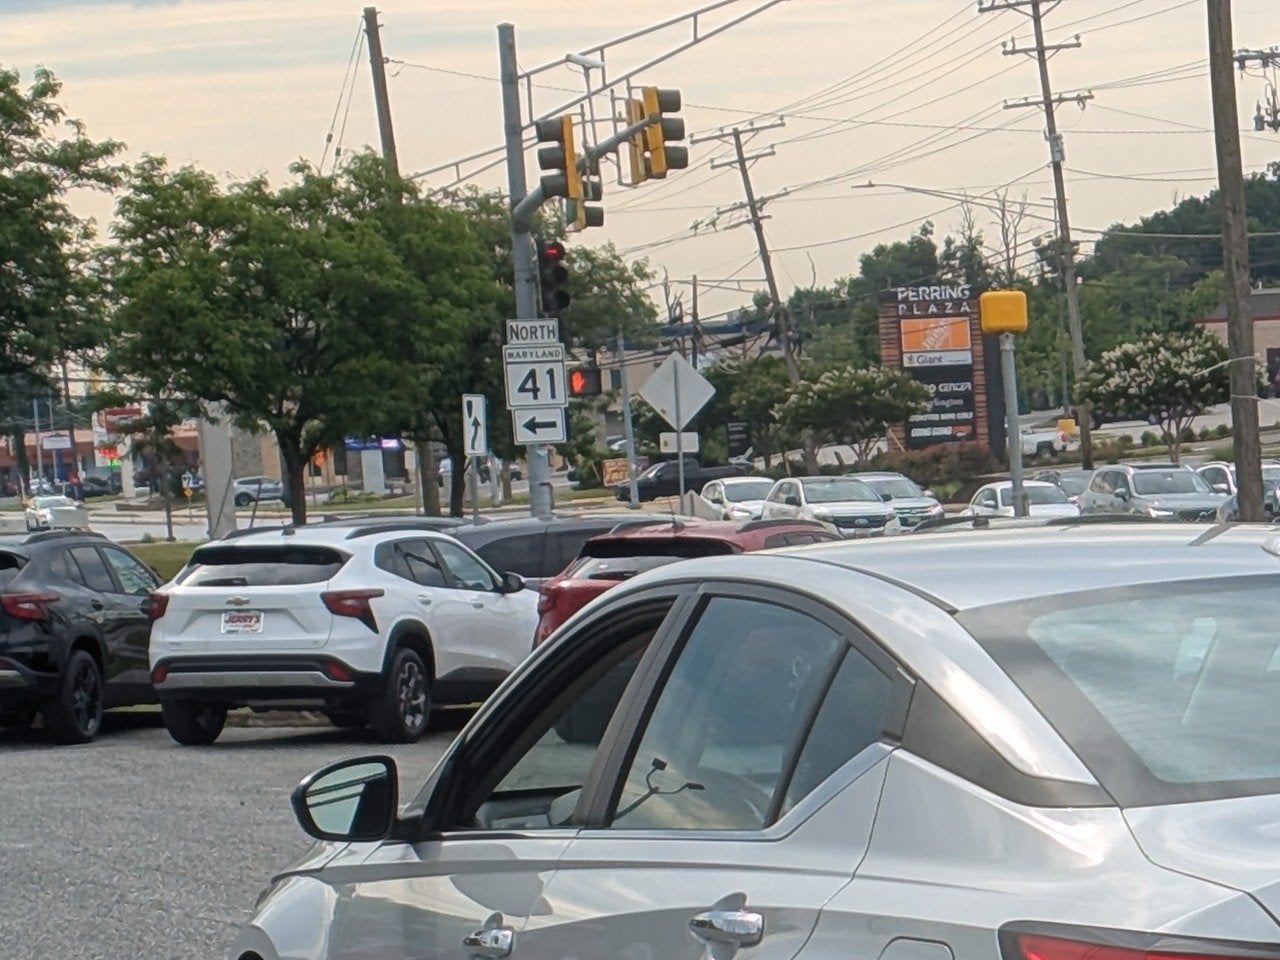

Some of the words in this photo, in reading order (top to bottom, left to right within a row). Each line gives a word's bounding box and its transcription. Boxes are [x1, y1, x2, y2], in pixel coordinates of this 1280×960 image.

[897, 284, 972, 300] PERRING
[898, 301, 971, 316] PLAZA
[509, 324, 556, 340] NORTH
[507, 349, 560, 359] MARYLAND
[518, 368, 557, 400] 41
